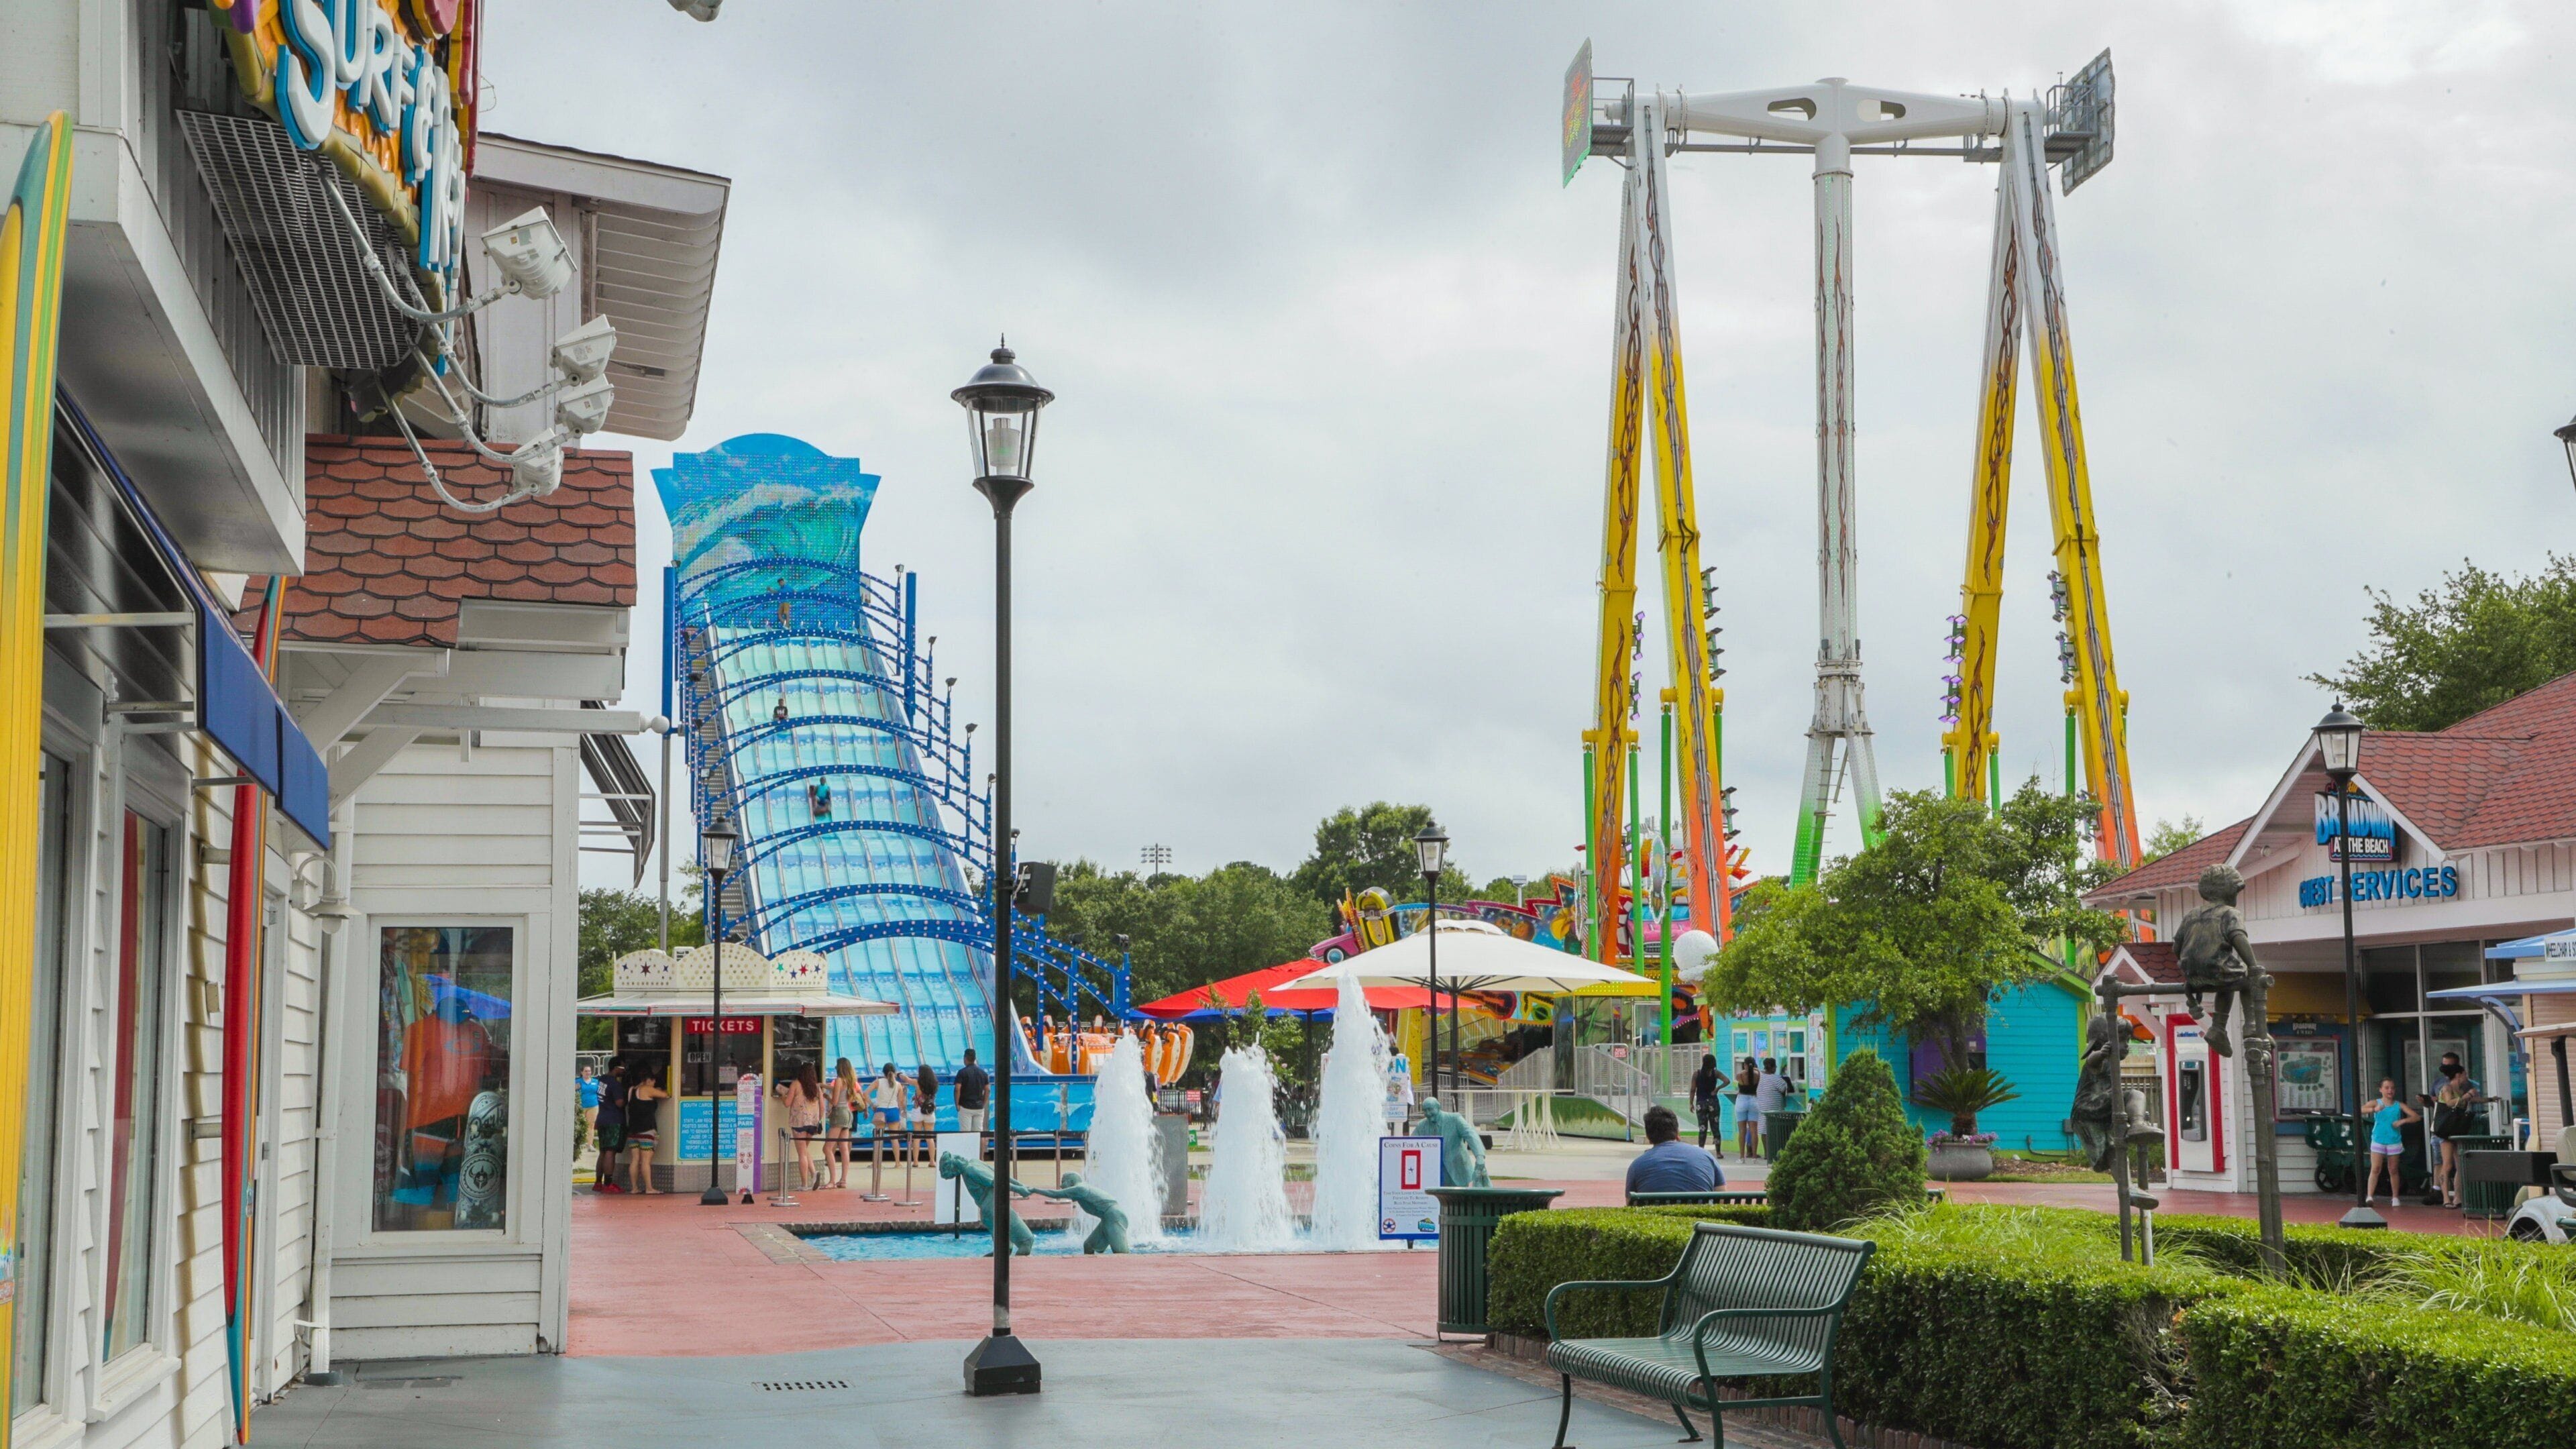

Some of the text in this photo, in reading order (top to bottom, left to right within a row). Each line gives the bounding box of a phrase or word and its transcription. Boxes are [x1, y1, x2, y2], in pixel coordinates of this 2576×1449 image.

[276, 0, 416, 150] SURF
[2314, 793, 2396, 847] BRADWAY
[2349, 837, 2363, 853] THE
[2365, 838, 2389, 853] BEACH
[2299, 866, 2457, 908] GUEST ERVICES
[690, 1053, 711, 1063] OPEN
